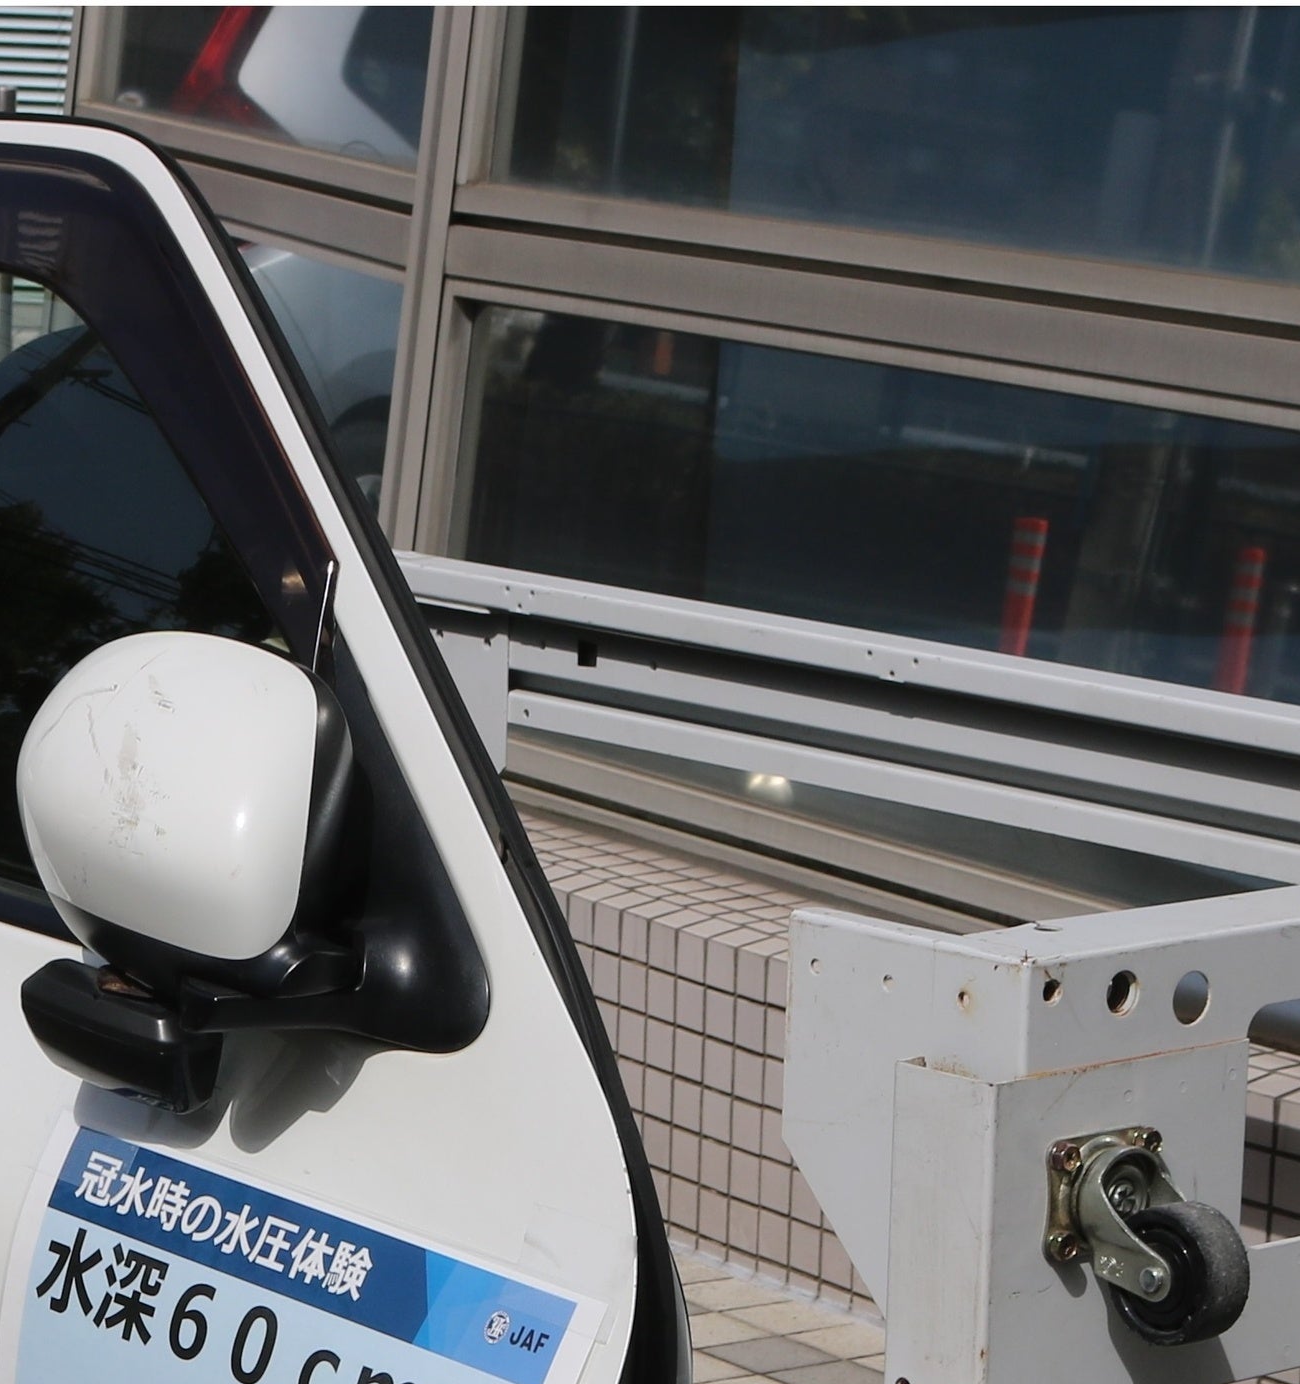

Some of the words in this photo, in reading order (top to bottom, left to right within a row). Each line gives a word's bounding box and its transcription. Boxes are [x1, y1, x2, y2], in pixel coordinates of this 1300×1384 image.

[74, 1150, 374, 1301] 冠水時の水圧体験
[509, 1325, 550, 1354] JAF
